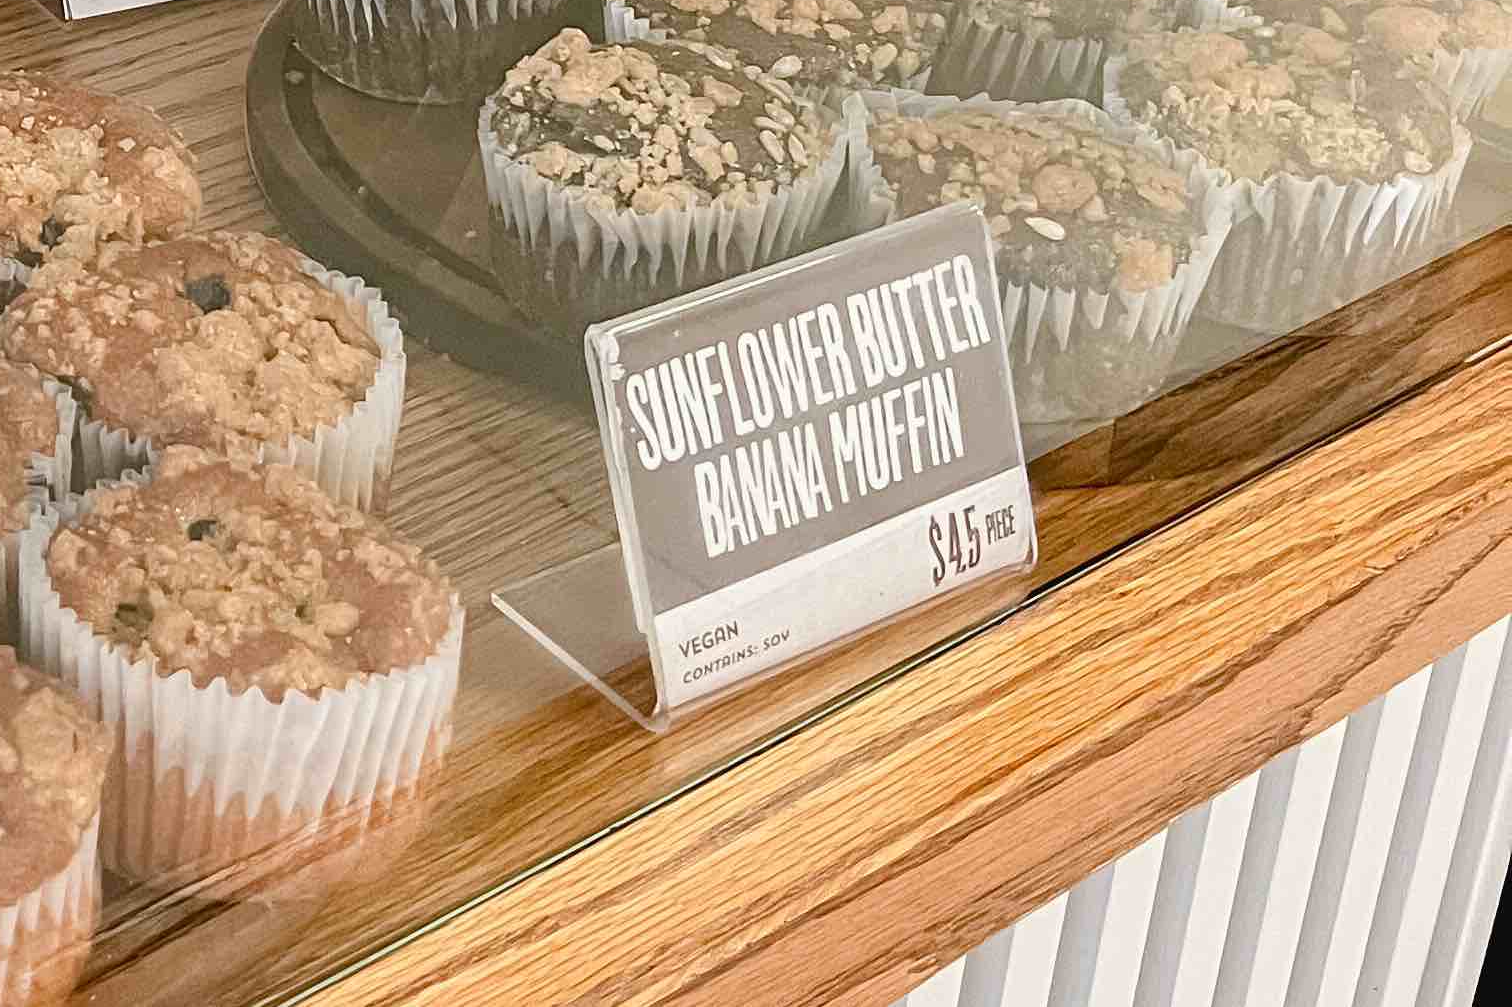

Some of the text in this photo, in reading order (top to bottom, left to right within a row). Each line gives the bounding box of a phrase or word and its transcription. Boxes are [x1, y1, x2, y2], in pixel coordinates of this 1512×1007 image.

[626, 254, 991, 471] SUNFLOWER BUTTER
[694, 367, 964, 559] BANANA MUFFIN
[985, 504, 1016, 545] PIECE
[678, 620, 738, 658] VEGAN
[683, 644, 760, 683] CONTAINS:
